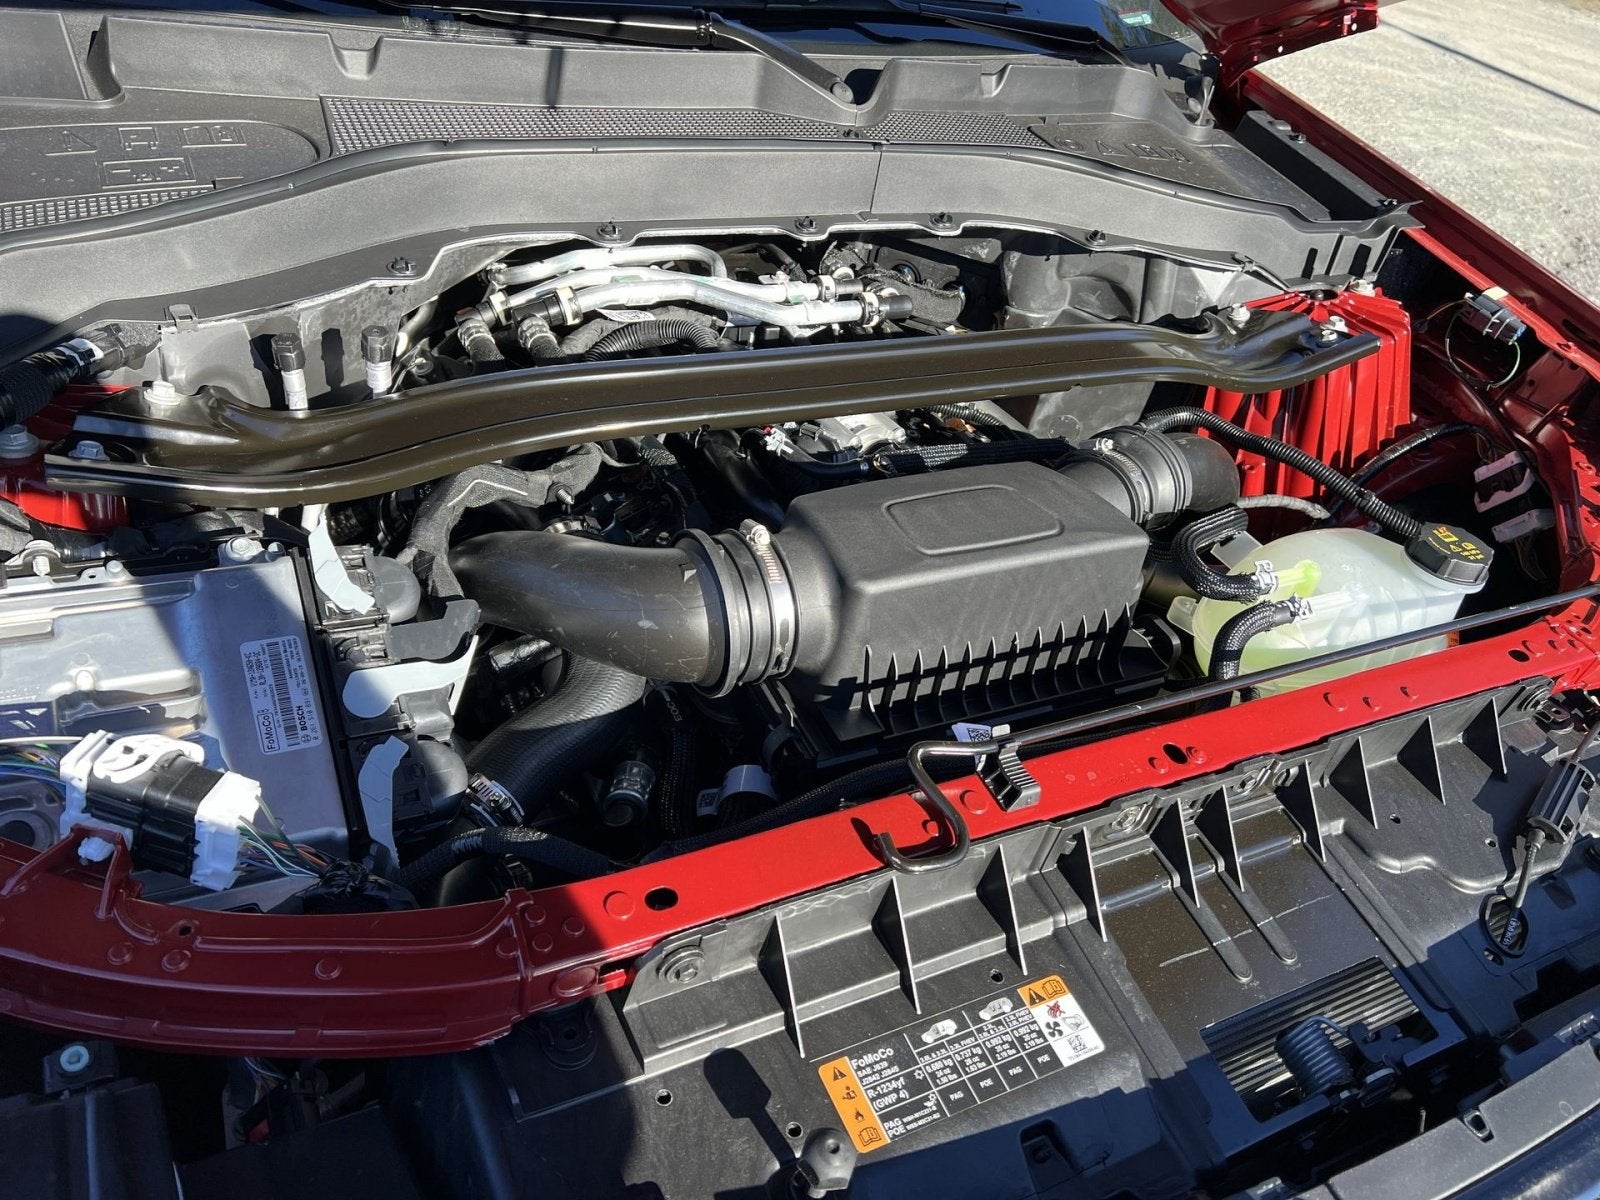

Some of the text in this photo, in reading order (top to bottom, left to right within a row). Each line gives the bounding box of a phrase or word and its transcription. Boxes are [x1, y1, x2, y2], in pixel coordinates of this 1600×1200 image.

[667, 701, 683, 721] EOC
[296, 705, 308, 731] BOSCH
[262, 715, 276, 750] FoMoCo
[1028, 1023, 1040, 1031] kg
[1001, 1034, 1012, 1042] kg
[851, 1048, 894, 1069] FoMoCo
[954, 1046, 982, 1061] 0.737 kg
[1037, 1054, 1050, 1063] POE
[942, 1058, 954, 1066] kg
[976, 1061, 987, 1069] lbs
[857, 1067, 872, 1077] SAE
[1008, 1066, 1022, 1076] PAG
[866, 1077, 905, 1098] R-1234yf
[979, 1078, 993, 1088] POE
[873, 1089, 909, 1111] (GWP 4)
[949, 1091, 964, 1101] PAG
[883, 1118, 902, 1130] PAG
[887, 1125, 906, 1137] POE
